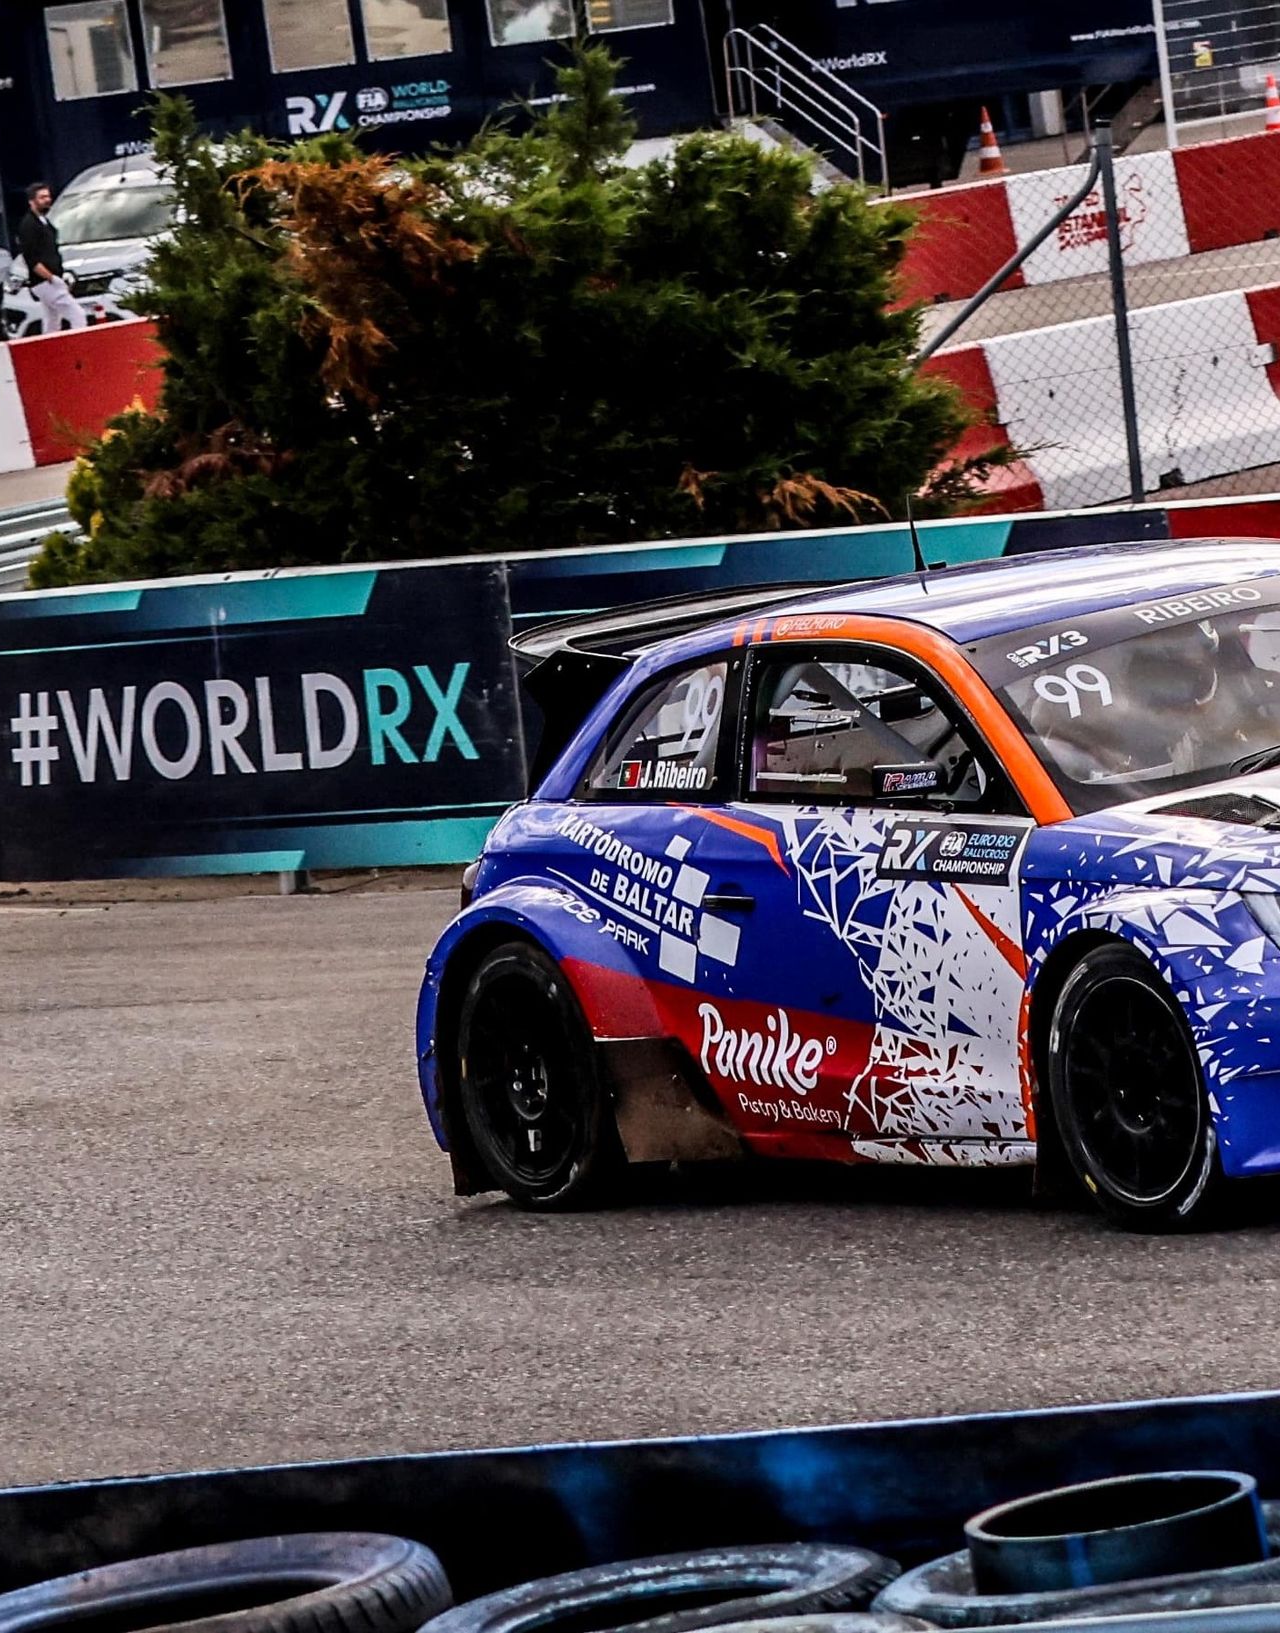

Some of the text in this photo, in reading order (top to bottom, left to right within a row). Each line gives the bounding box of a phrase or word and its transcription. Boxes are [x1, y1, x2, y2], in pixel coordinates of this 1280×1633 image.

[285, 91, 350, 135] RX
[1134, 587, 1262, 625] RIBEIRO
[1017, 631, 1089, 665] RX3
[1033, 664, 1113, 719] 99
[10, 662, 480, 787] #WORLDRX
[682, 675, 724, 764] 99
[640, 761, 707, 789] J.Ribeiro
[556, 813, 673, 889] KARTÓDROMO
[881, 829, 942, 870] RX
[940, 835, 966, 853] FIA
[962, 847, 1010, 860] RALLYCROSS
[968, 833, 1017, 848] EURO RX3
[933, 859, 1005, 875] CHAMPIONSHIP
[590, 868, 694, 936] DE BALTAR
[598, 919, 650, 955] PARK
[790, 1100, 842, 1129] Bakery
